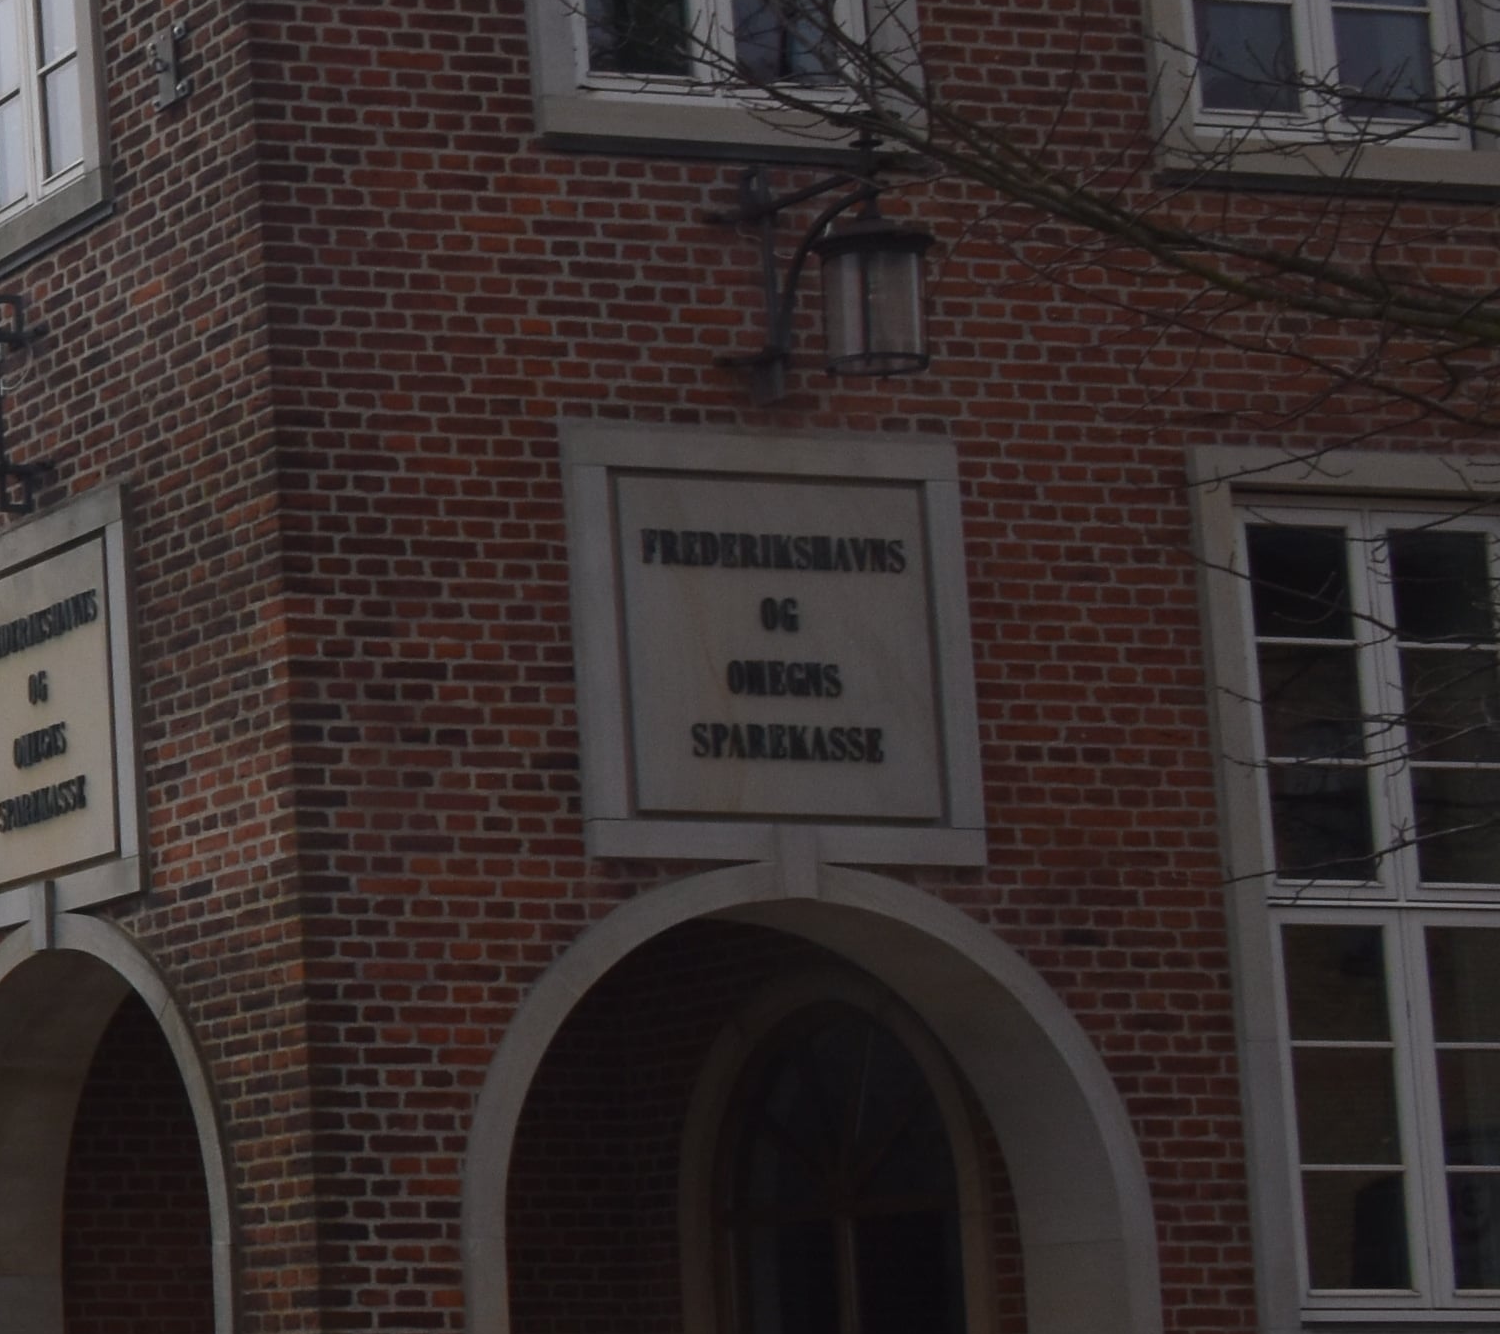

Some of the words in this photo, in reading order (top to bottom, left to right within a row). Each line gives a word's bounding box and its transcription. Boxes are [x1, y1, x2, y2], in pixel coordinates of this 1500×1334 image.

[640, 527, 907, 575] FREDERIKSHAVNS
[760, 596, 800, 635] OG
[27, 669, 48, 706] OG
[726, 658, 843, 699] OMEGNS
[691, 721, 885, 766] SPAREKASSE
